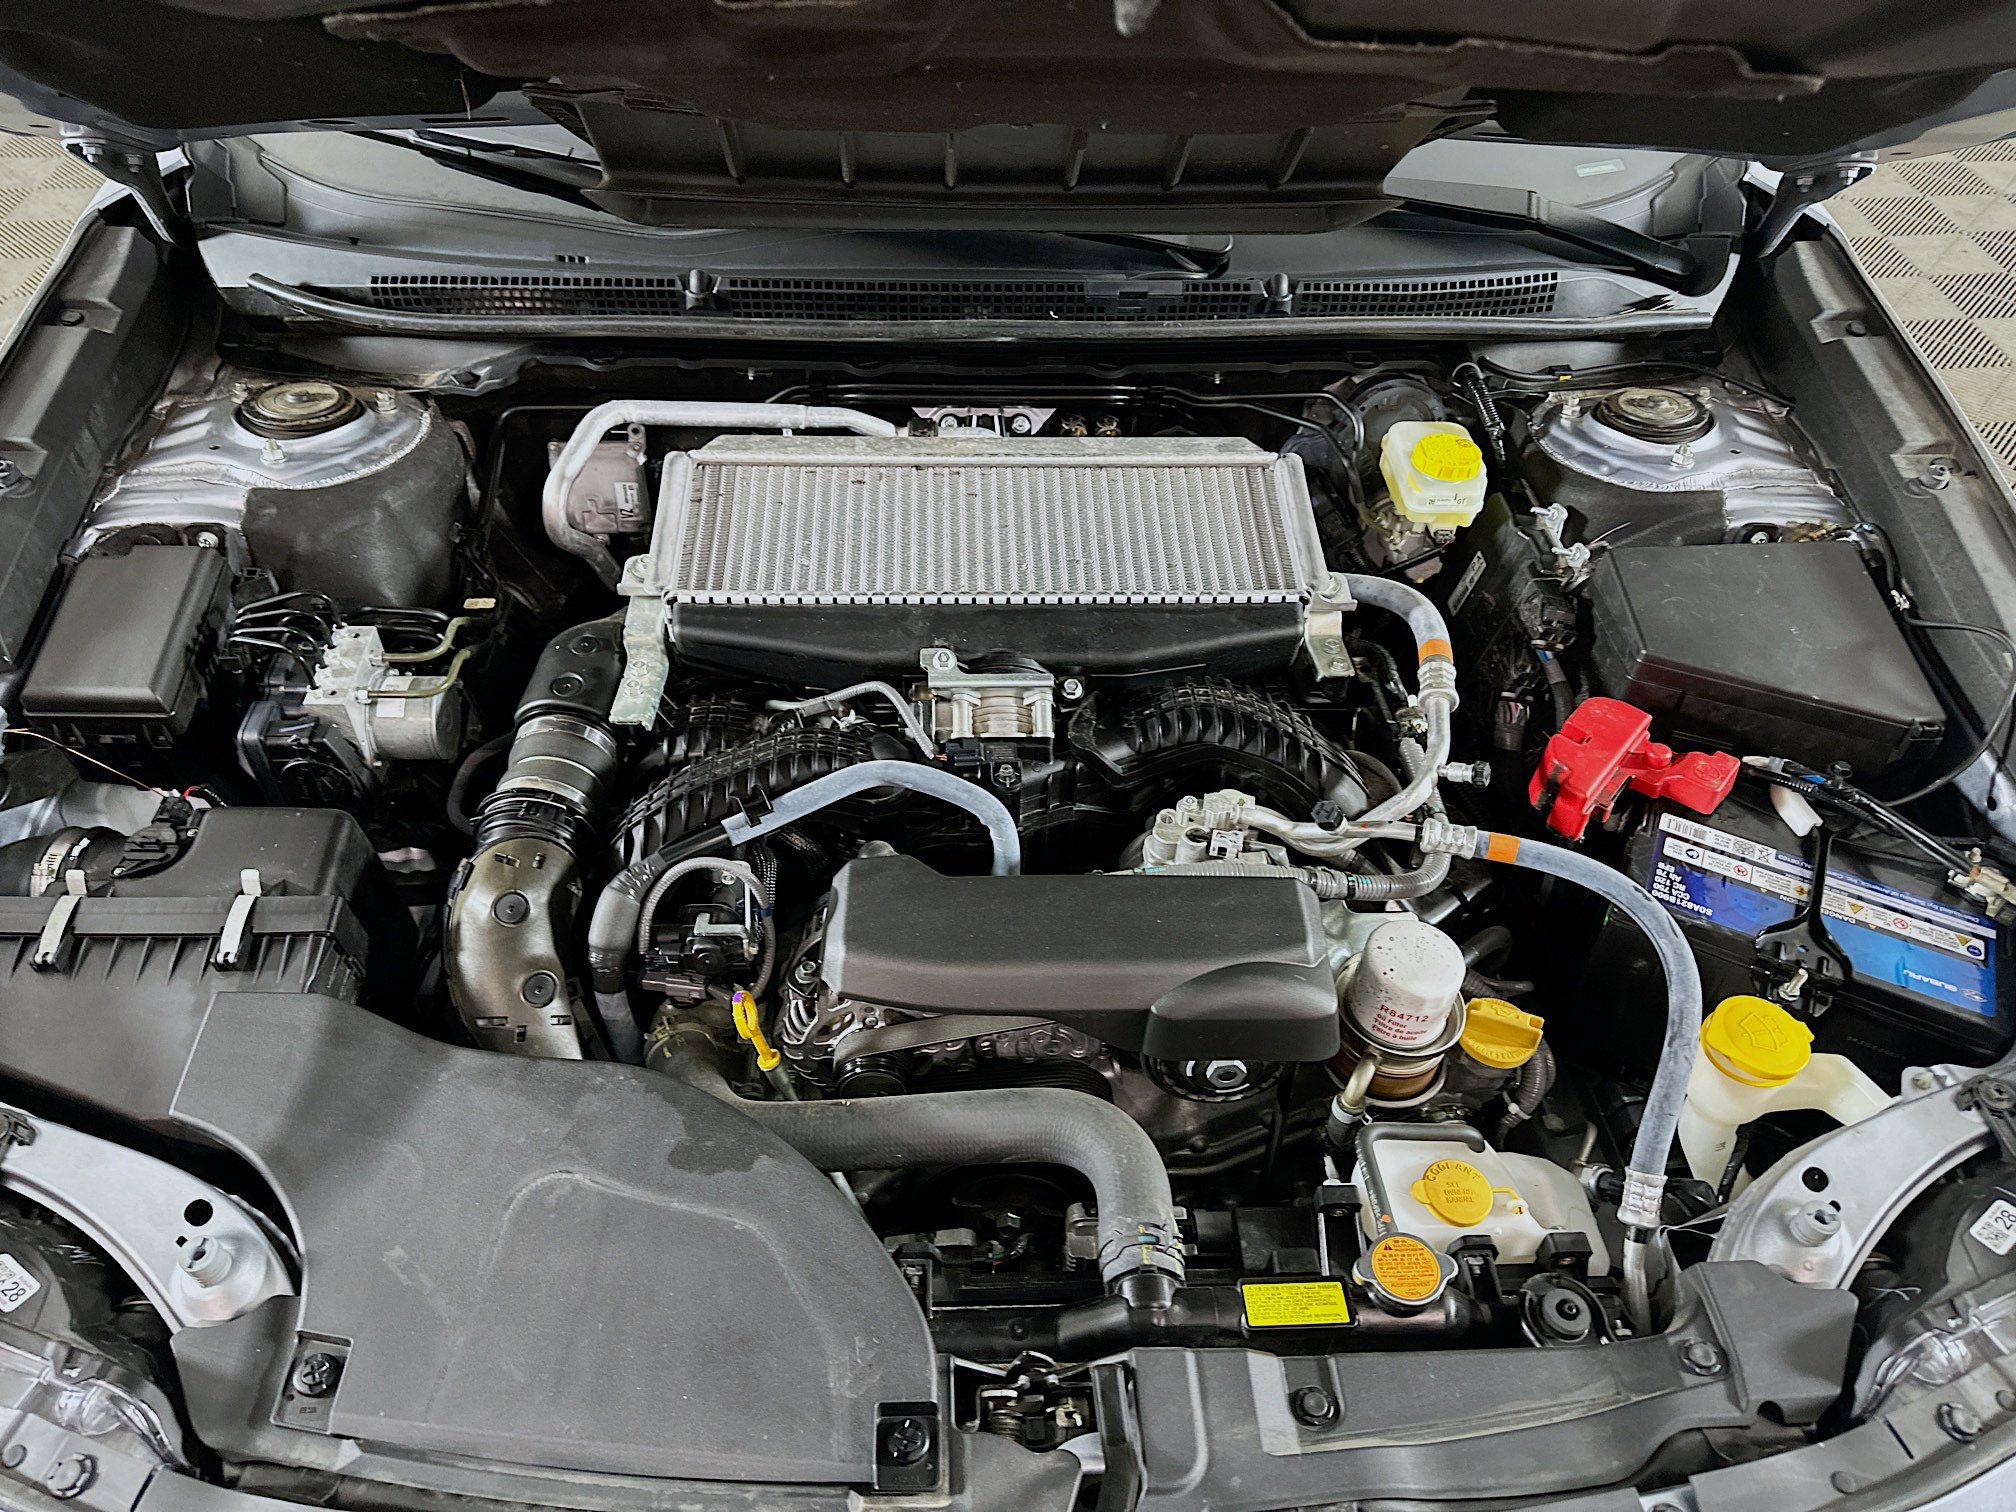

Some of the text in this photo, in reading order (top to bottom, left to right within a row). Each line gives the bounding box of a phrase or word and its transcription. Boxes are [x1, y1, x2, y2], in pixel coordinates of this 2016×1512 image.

[1653, 875, 1687, 892] RC 120
[1668, 872, 1682, 882] Ah
[1652, 882, 1690, 901] CCA 750
[1820, 907, 1857, 924] DANGE
[1903, 969, 1958, 993] SUBARU
[1379, 1004, 1429, 1023] R84712
[1995, 1209, 2016, 1230] 28
[1, 1281, 27, 1303] 28
